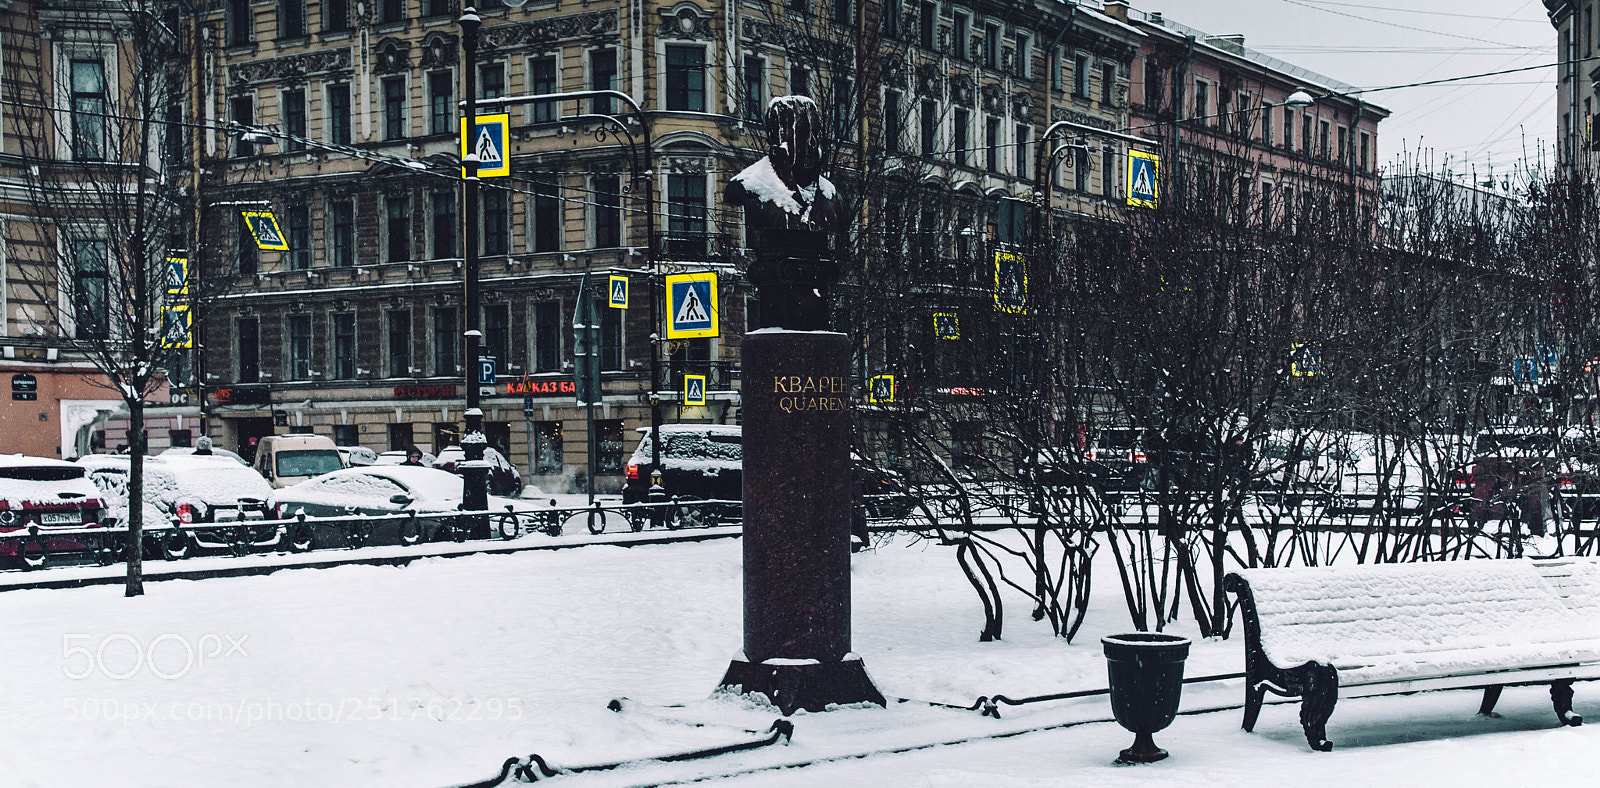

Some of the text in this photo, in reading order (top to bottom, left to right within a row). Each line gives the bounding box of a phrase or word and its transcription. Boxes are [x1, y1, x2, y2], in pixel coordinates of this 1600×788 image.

[394, 385, 455, 397] РЕСТОРАН
[506, 381, 576, 394] КАКАЗ БА
[773, 376, 849, 393] КВАРЕН
